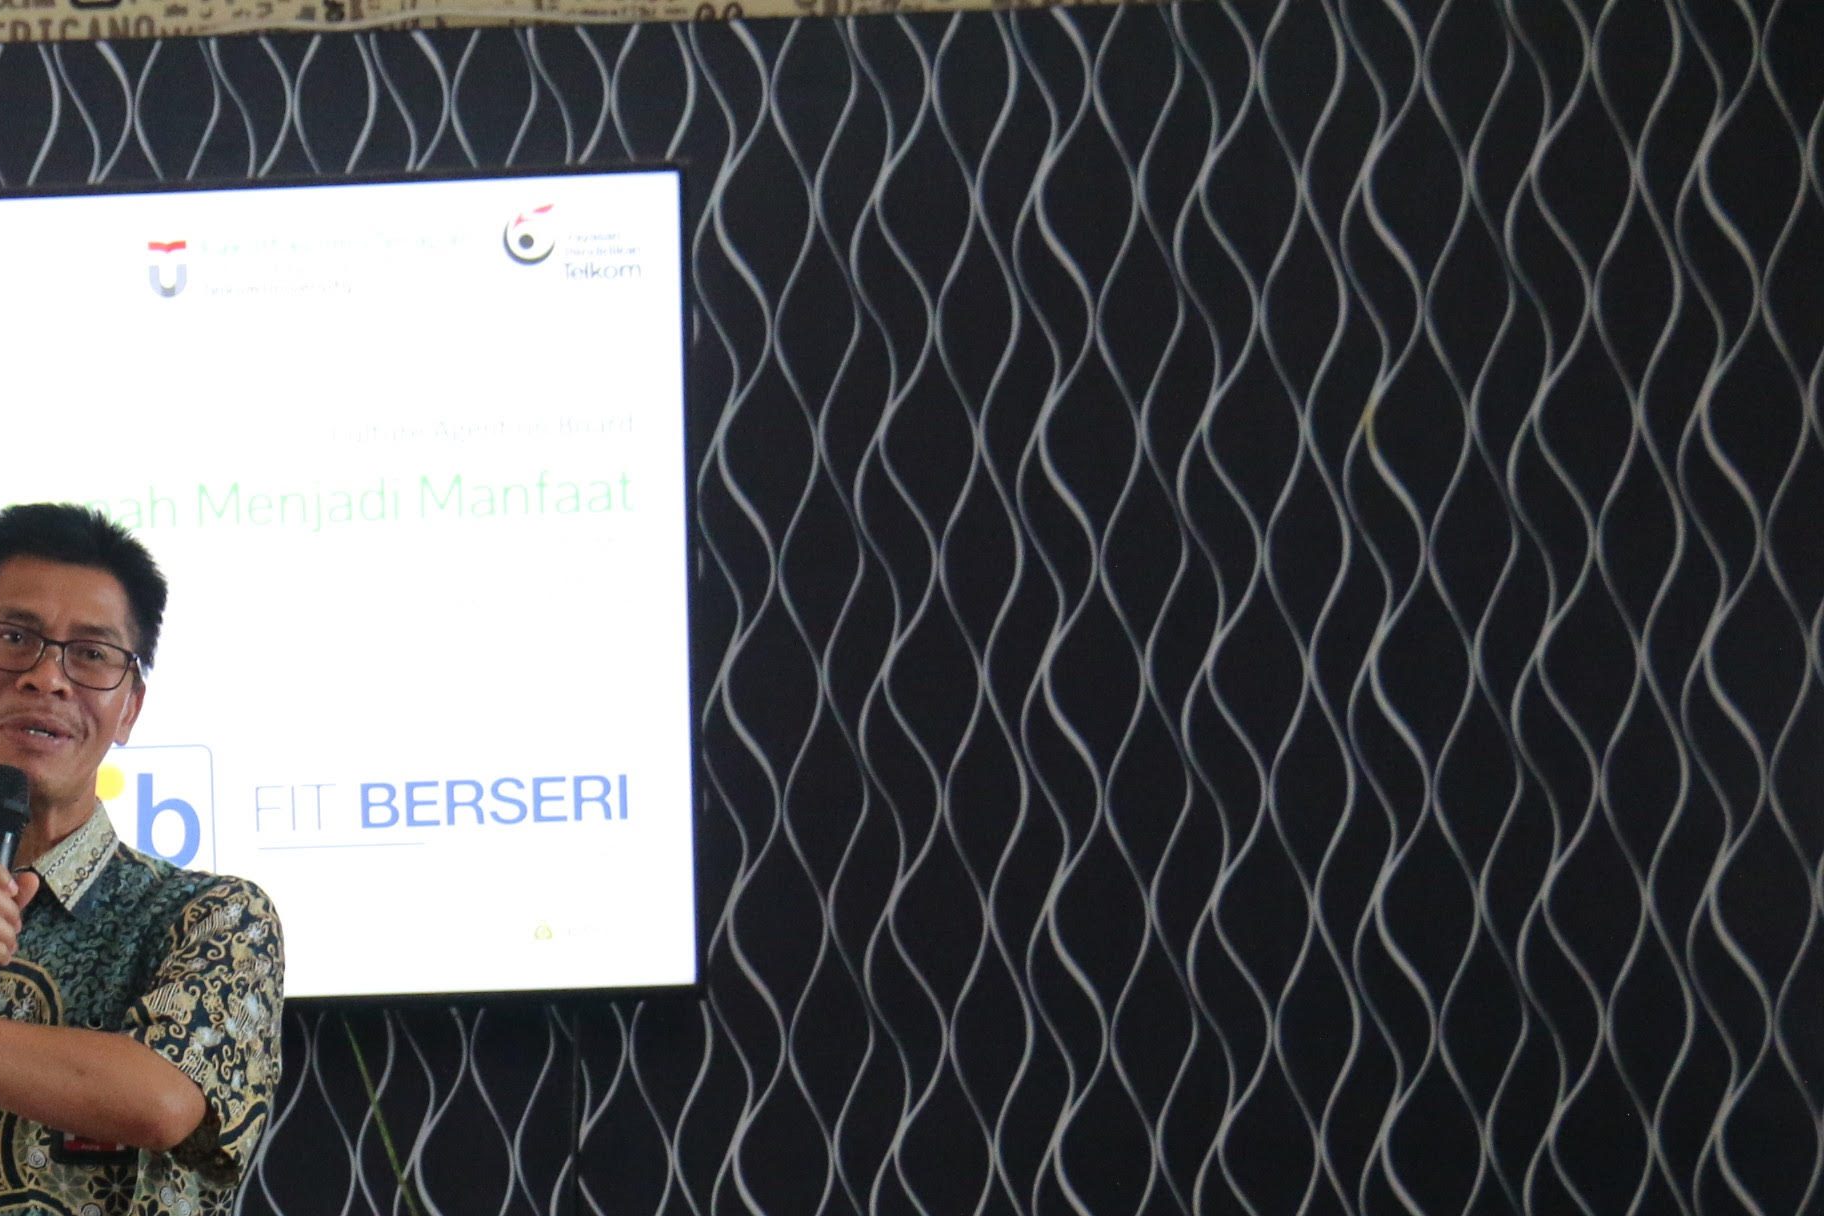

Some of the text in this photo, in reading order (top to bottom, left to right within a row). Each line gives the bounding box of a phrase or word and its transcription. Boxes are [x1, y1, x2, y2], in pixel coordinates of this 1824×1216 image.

[562, 261, 643, 281] Telkom
[196, 478, 401, 533] Menjadi
[420, 470, 635, 522] Manfaat
[255, 784, 337, 832] FIT
[359, 774, 629, 830] BERSERI
